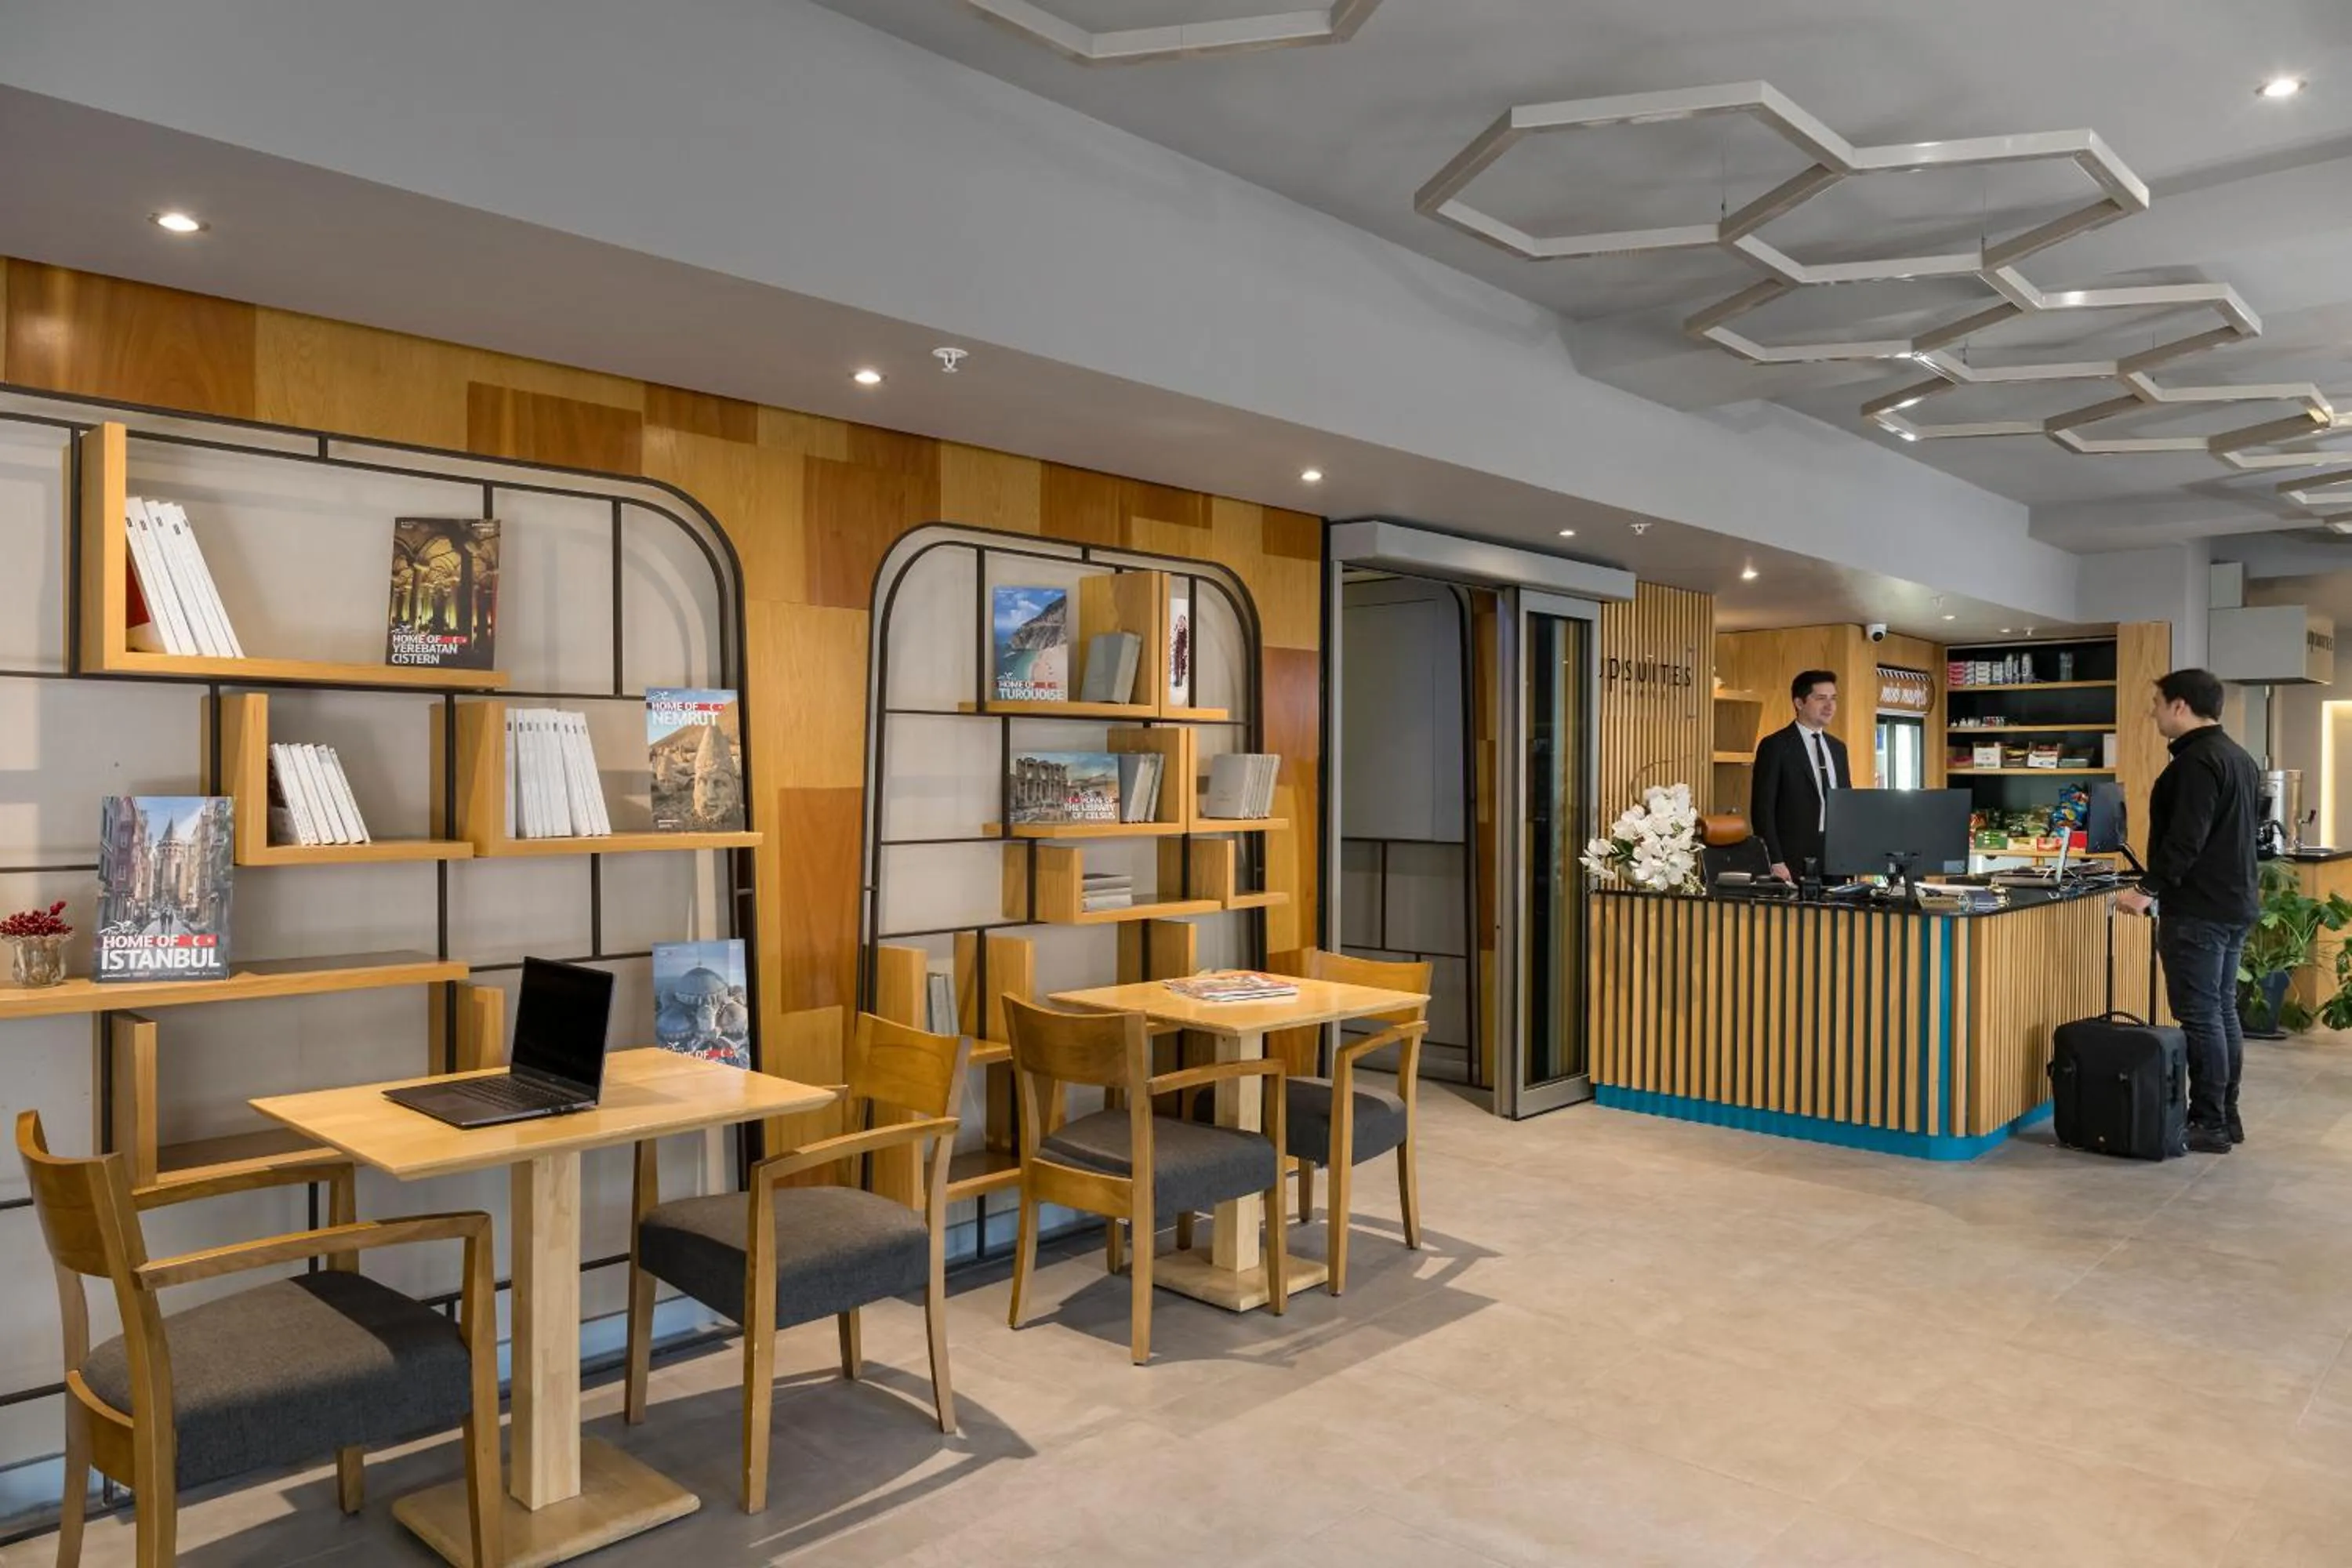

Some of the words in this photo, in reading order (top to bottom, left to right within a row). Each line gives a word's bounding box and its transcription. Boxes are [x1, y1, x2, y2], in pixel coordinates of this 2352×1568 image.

[393, 644, 458, 653] YEREBATAN
[392, 654, 439, 664] CISTERN
[652, 711, 718, 726] NEMRUT
[102, 935, 154, 948] HOME
[157, 935, 179, 947] OF
[101, 949, 220, 970] ISTANBUL
